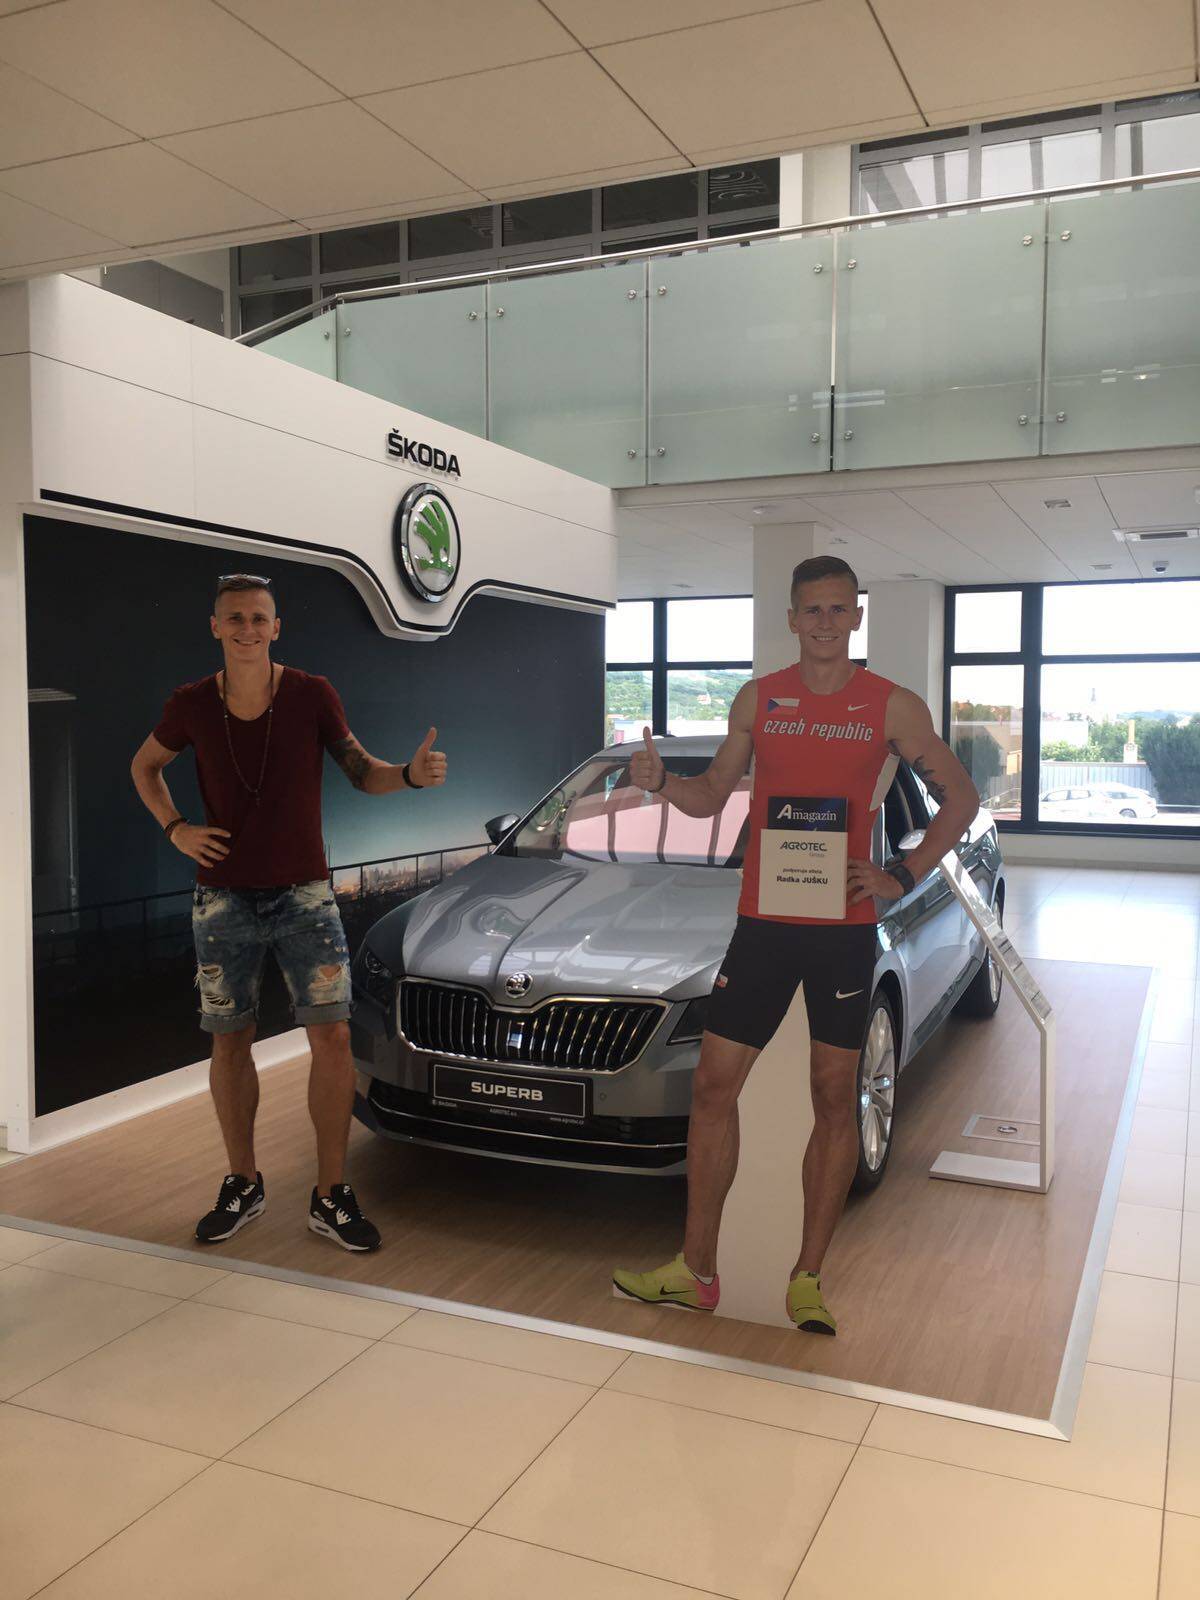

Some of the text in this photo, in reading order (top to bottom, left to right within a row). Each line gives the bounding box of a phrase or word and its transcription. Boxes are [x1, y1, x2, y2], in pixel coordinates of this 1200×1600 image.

[387, 428, 461, 477] ŠKODA
[763, 718, 873, 742] czech republic
[780, 841, 827, 852] AGROTEC
[470, 1081, 543, 1101] SUPERB
